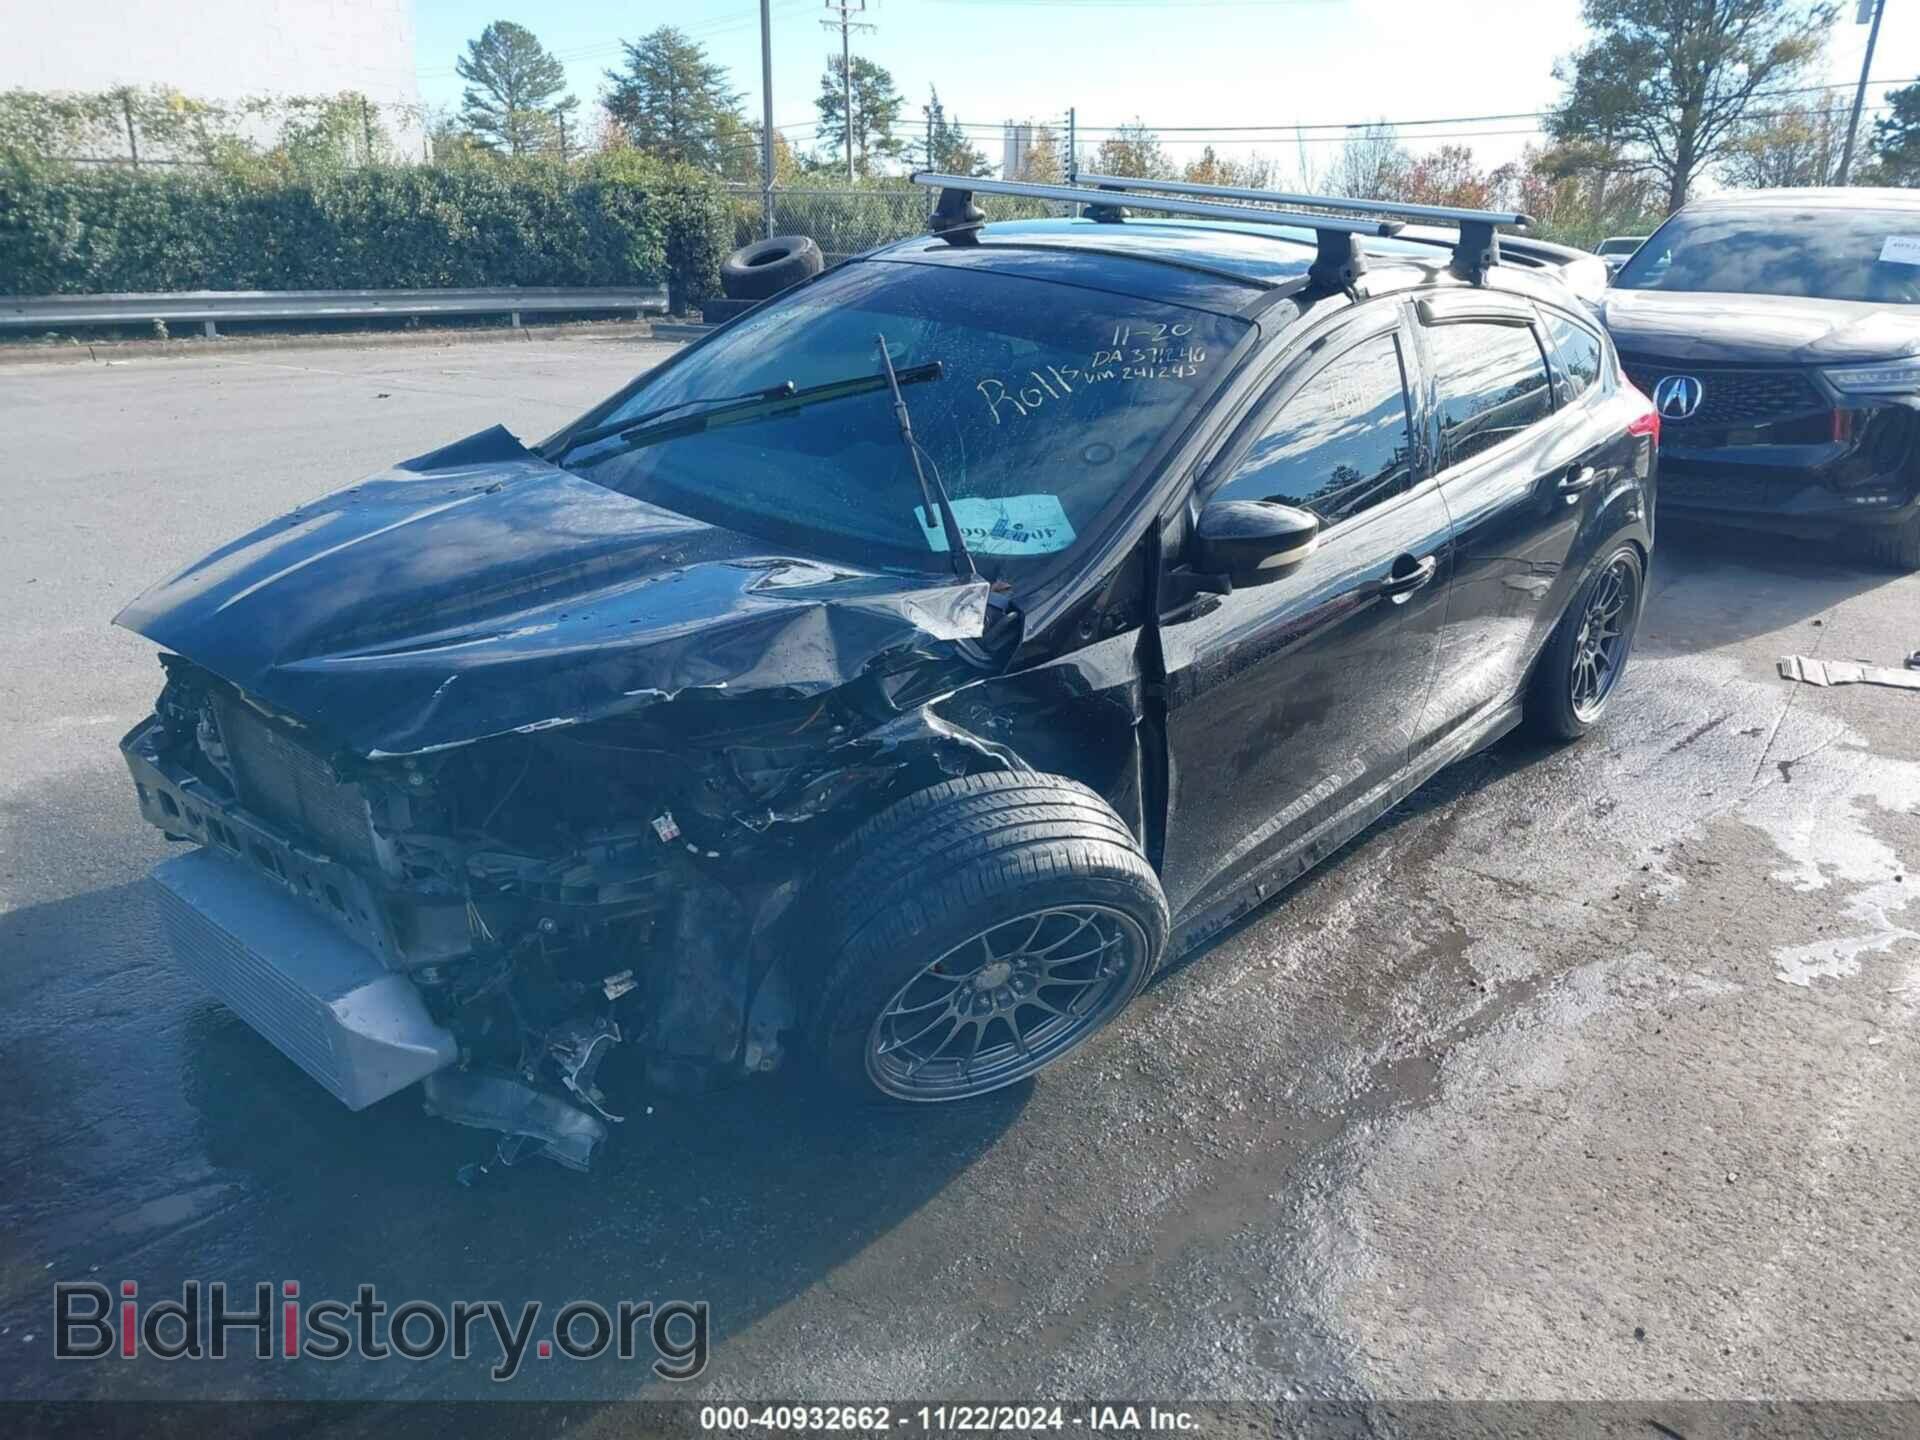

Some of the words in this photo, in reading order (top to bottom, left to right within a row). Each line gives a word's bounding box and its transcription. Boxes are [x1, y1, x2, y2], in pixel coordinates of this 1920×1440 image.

[1111, 323, 1192, 346] 11-20
[1091, 350, 1122, 368] DA
[1122, 364, 1198, 380] 241245
[976, 364, 1079, 424] Rolls
